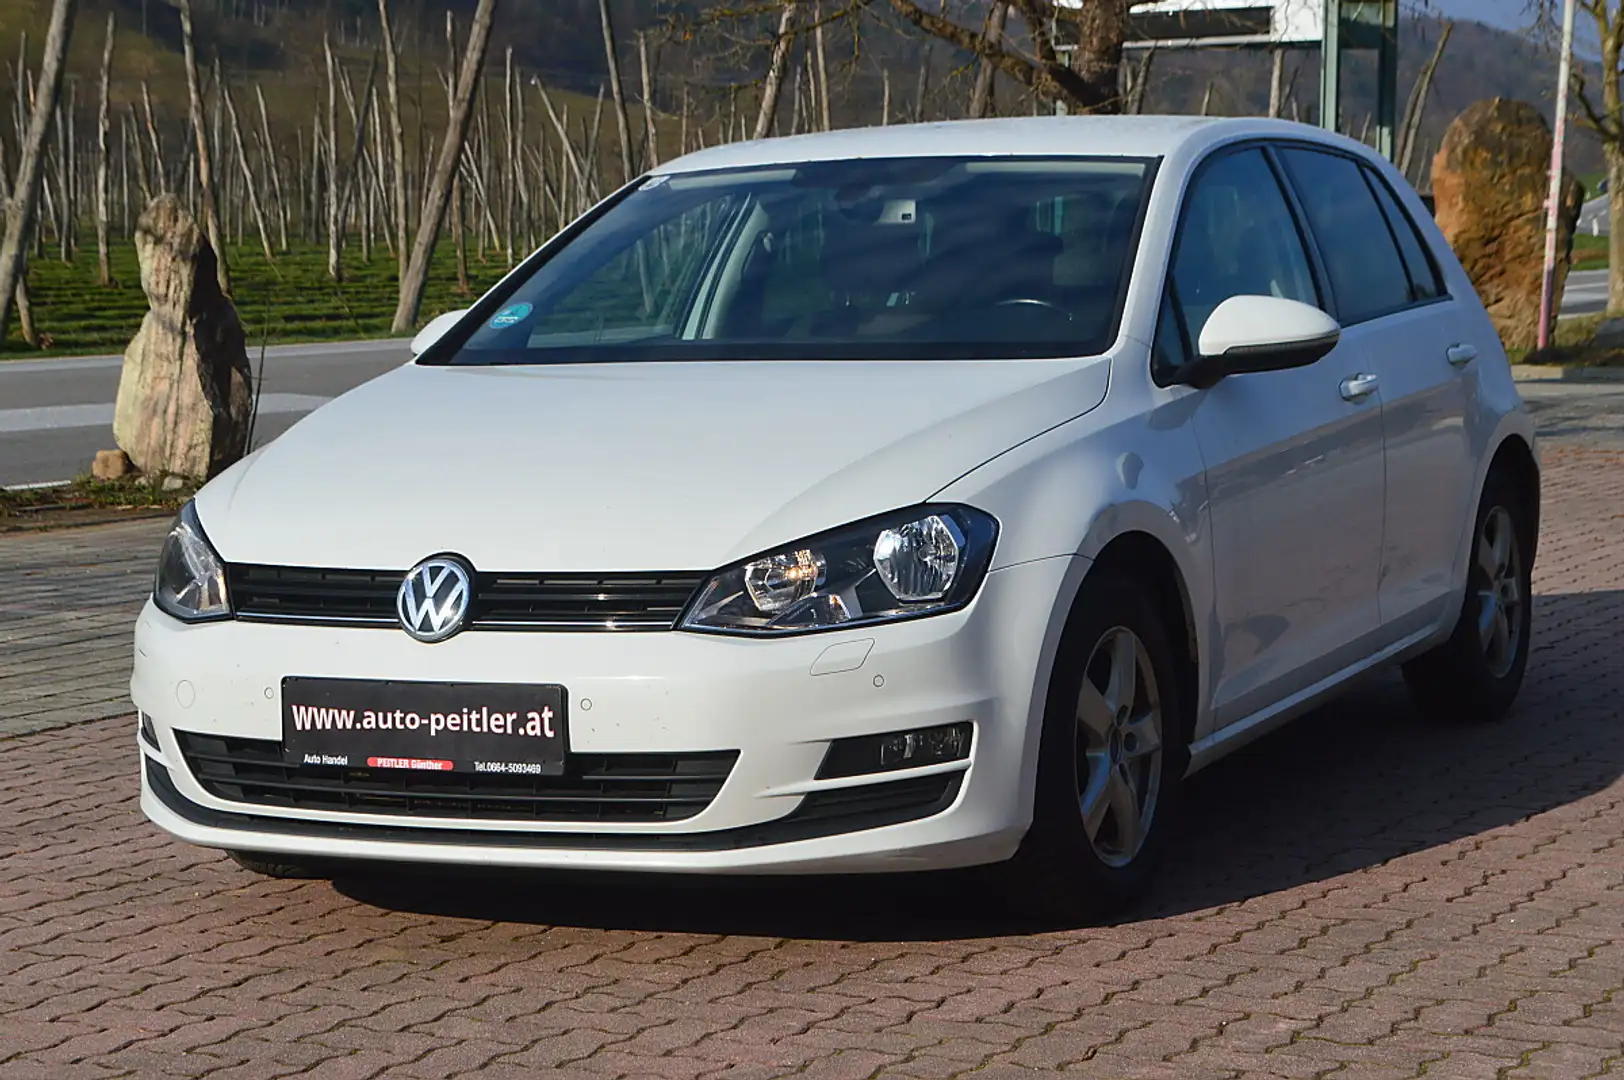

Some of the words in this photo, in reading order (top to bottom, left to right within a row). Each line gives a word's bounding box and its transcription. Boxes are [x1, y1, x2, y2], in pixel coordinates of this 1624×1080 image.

[303, 753, 321, 765] Auto
[322, 755, 348, 766] Handel
[377, 757, 409, 769] PEITLER
